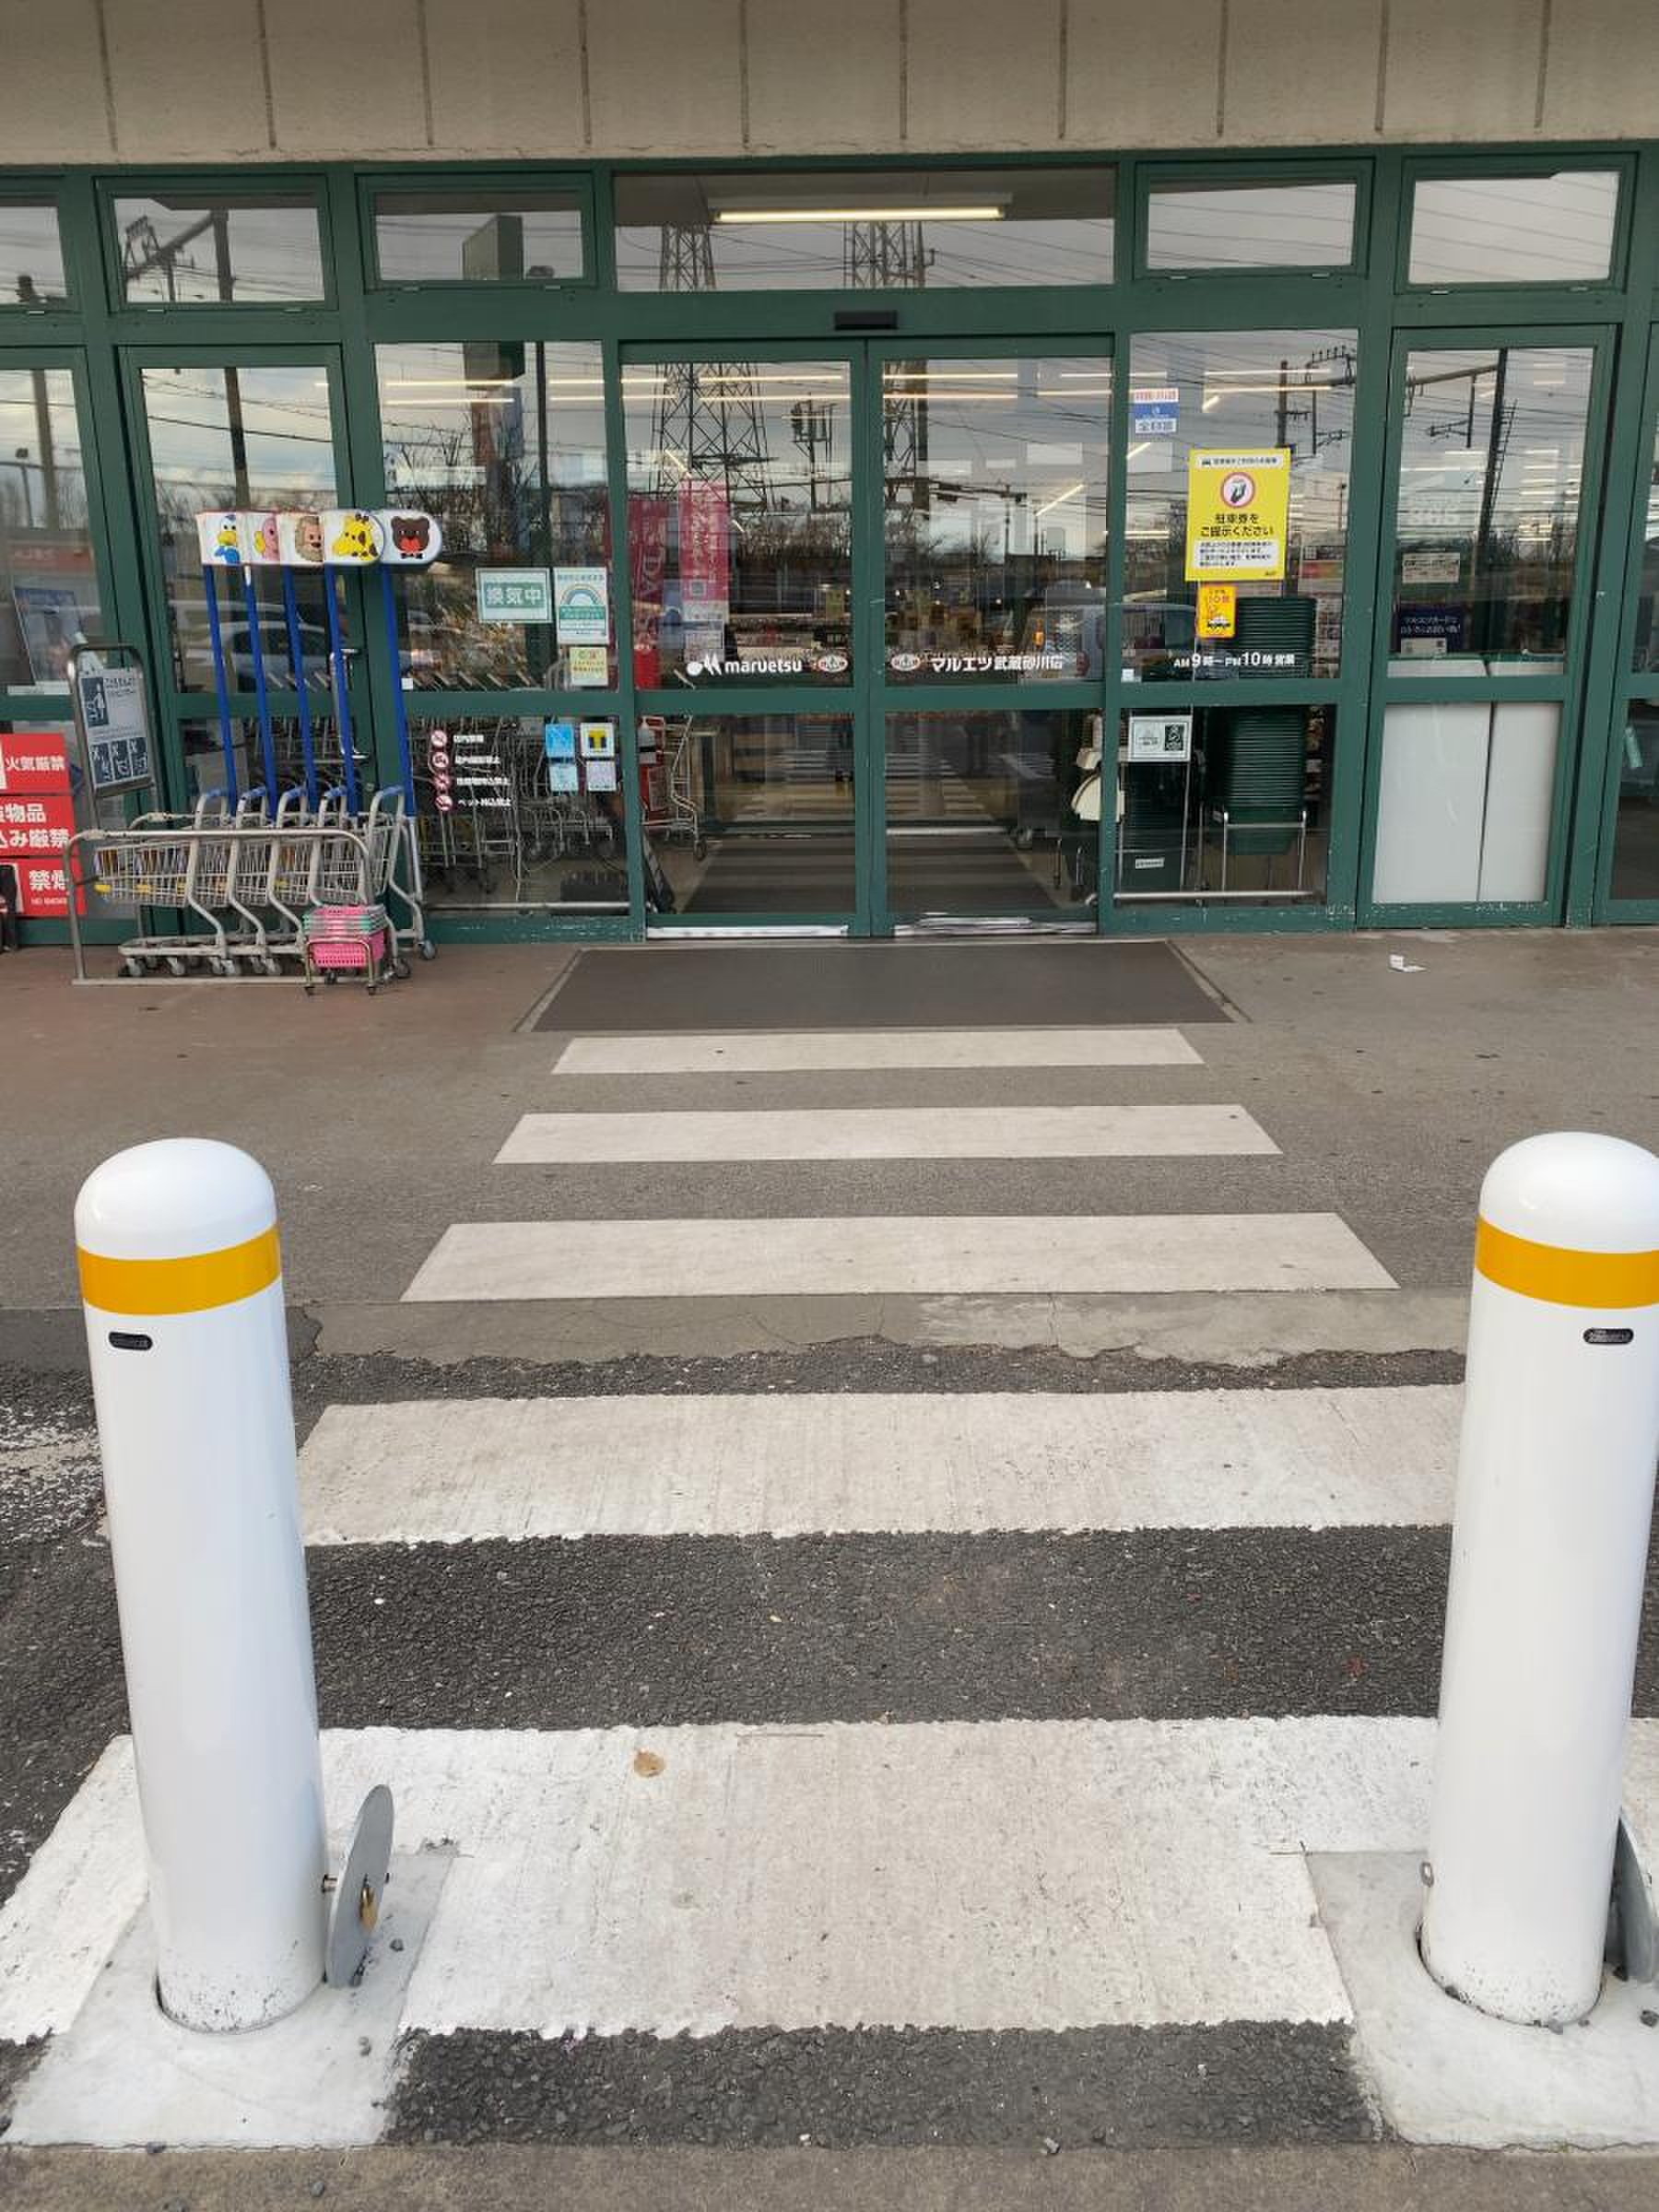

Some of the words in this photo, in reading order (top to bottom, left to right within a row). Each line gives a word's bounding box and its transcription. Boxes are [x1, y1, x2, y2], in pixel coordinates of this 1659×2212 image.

[1216, 513, 1259, 524] 駐車券を
[1201, 525, 1275, 537] ご提示ください
[486, 587, 542, 606] 換気中
[724, 658, 803, 674] maruetsu
[6, 756, 65, 772] 火気厳禁
[0, 803, 46, 824] 物品
